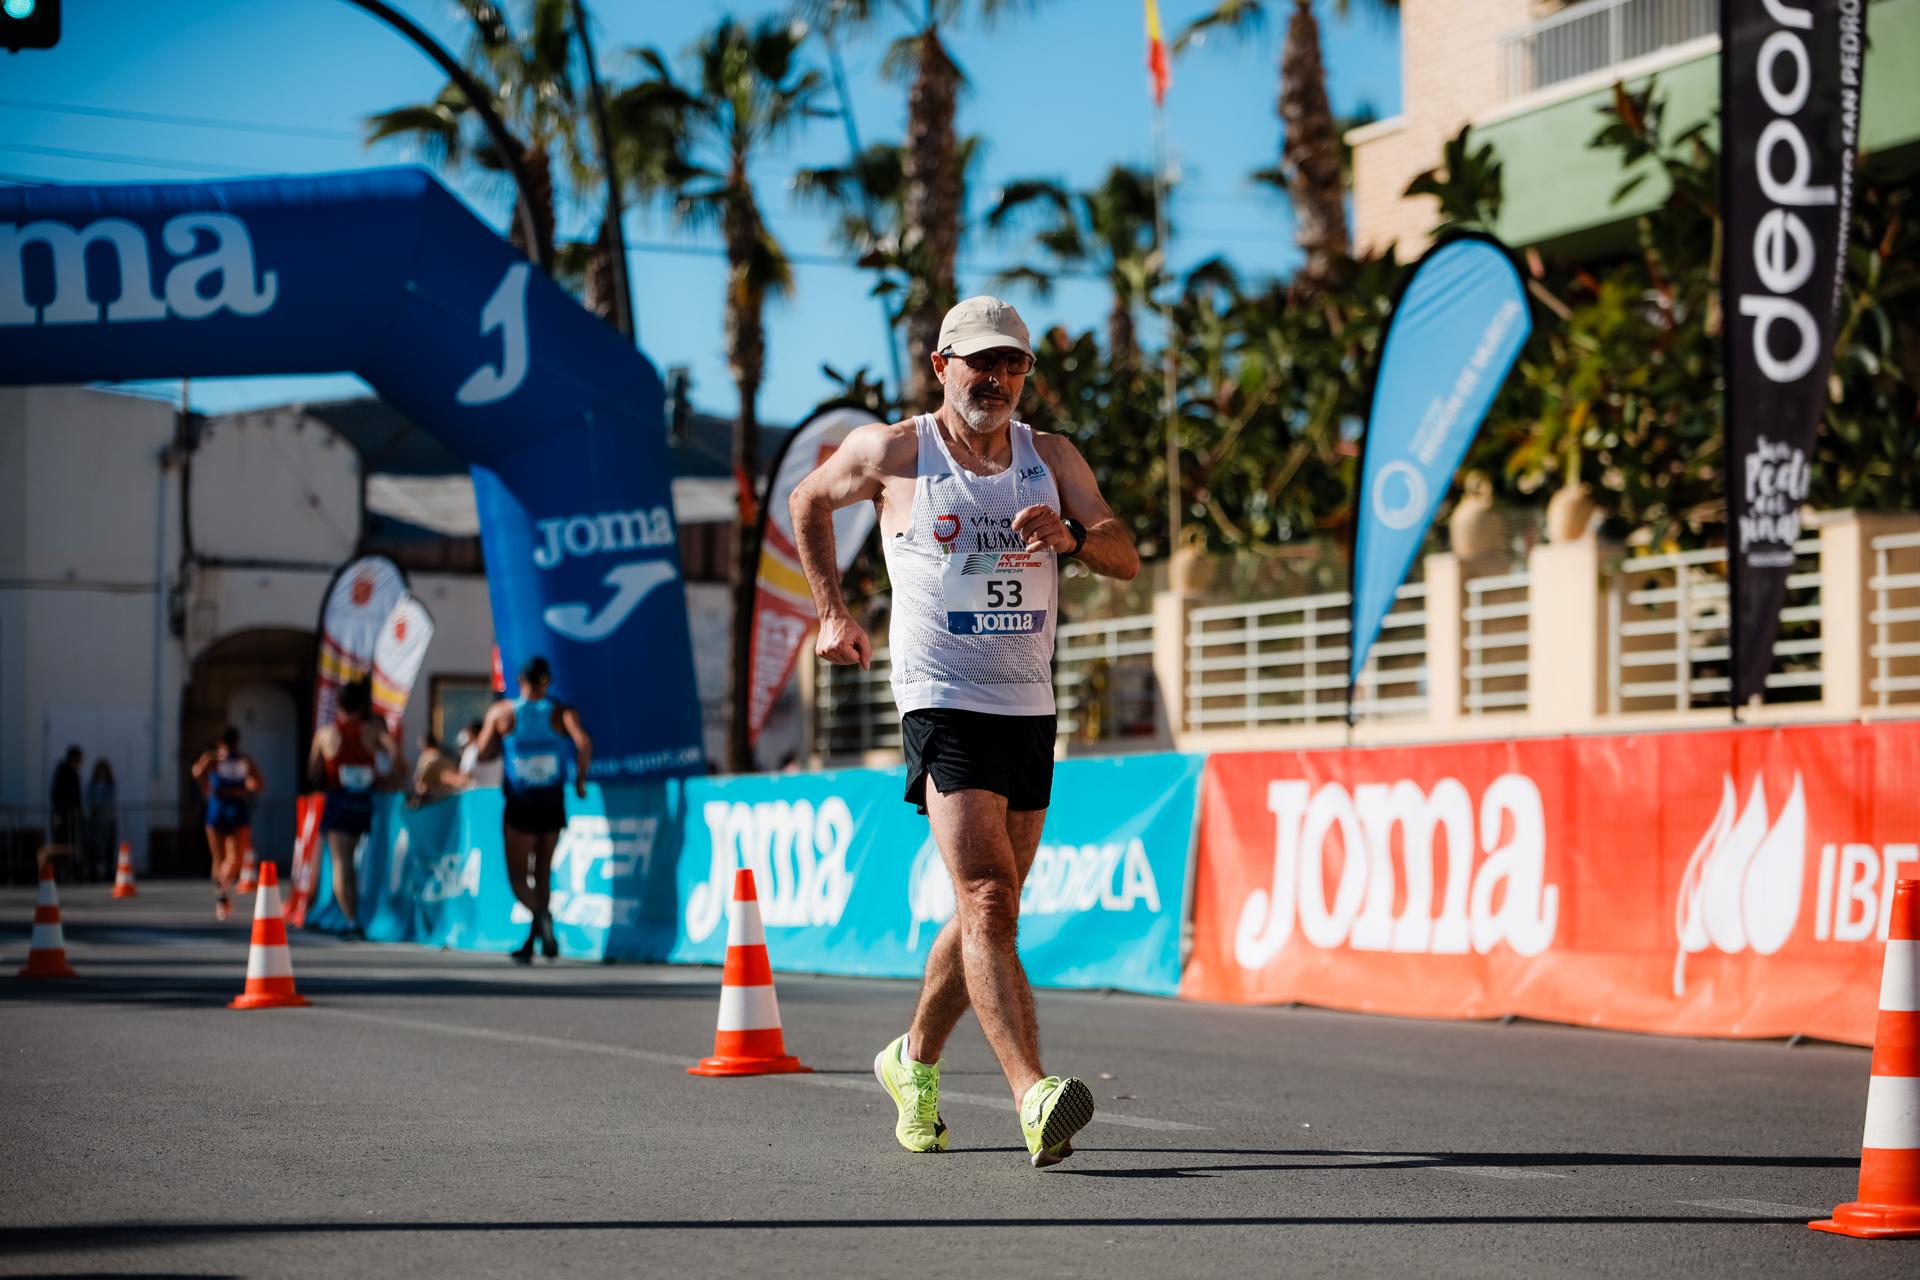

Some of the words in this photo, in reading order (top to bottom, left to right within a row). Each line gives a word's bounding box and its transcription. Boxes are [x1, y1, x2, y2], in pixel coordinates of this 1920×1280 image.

[533, 507, 675, 569] Joma
[977, 531, 1027, 553] JUMI
[987, 580, 1023, 609] 53
[972, 612, 1033, 634] Joma
[685, 796, 854, 943] Joma
[1235, 773, 1559, 971] Joma
